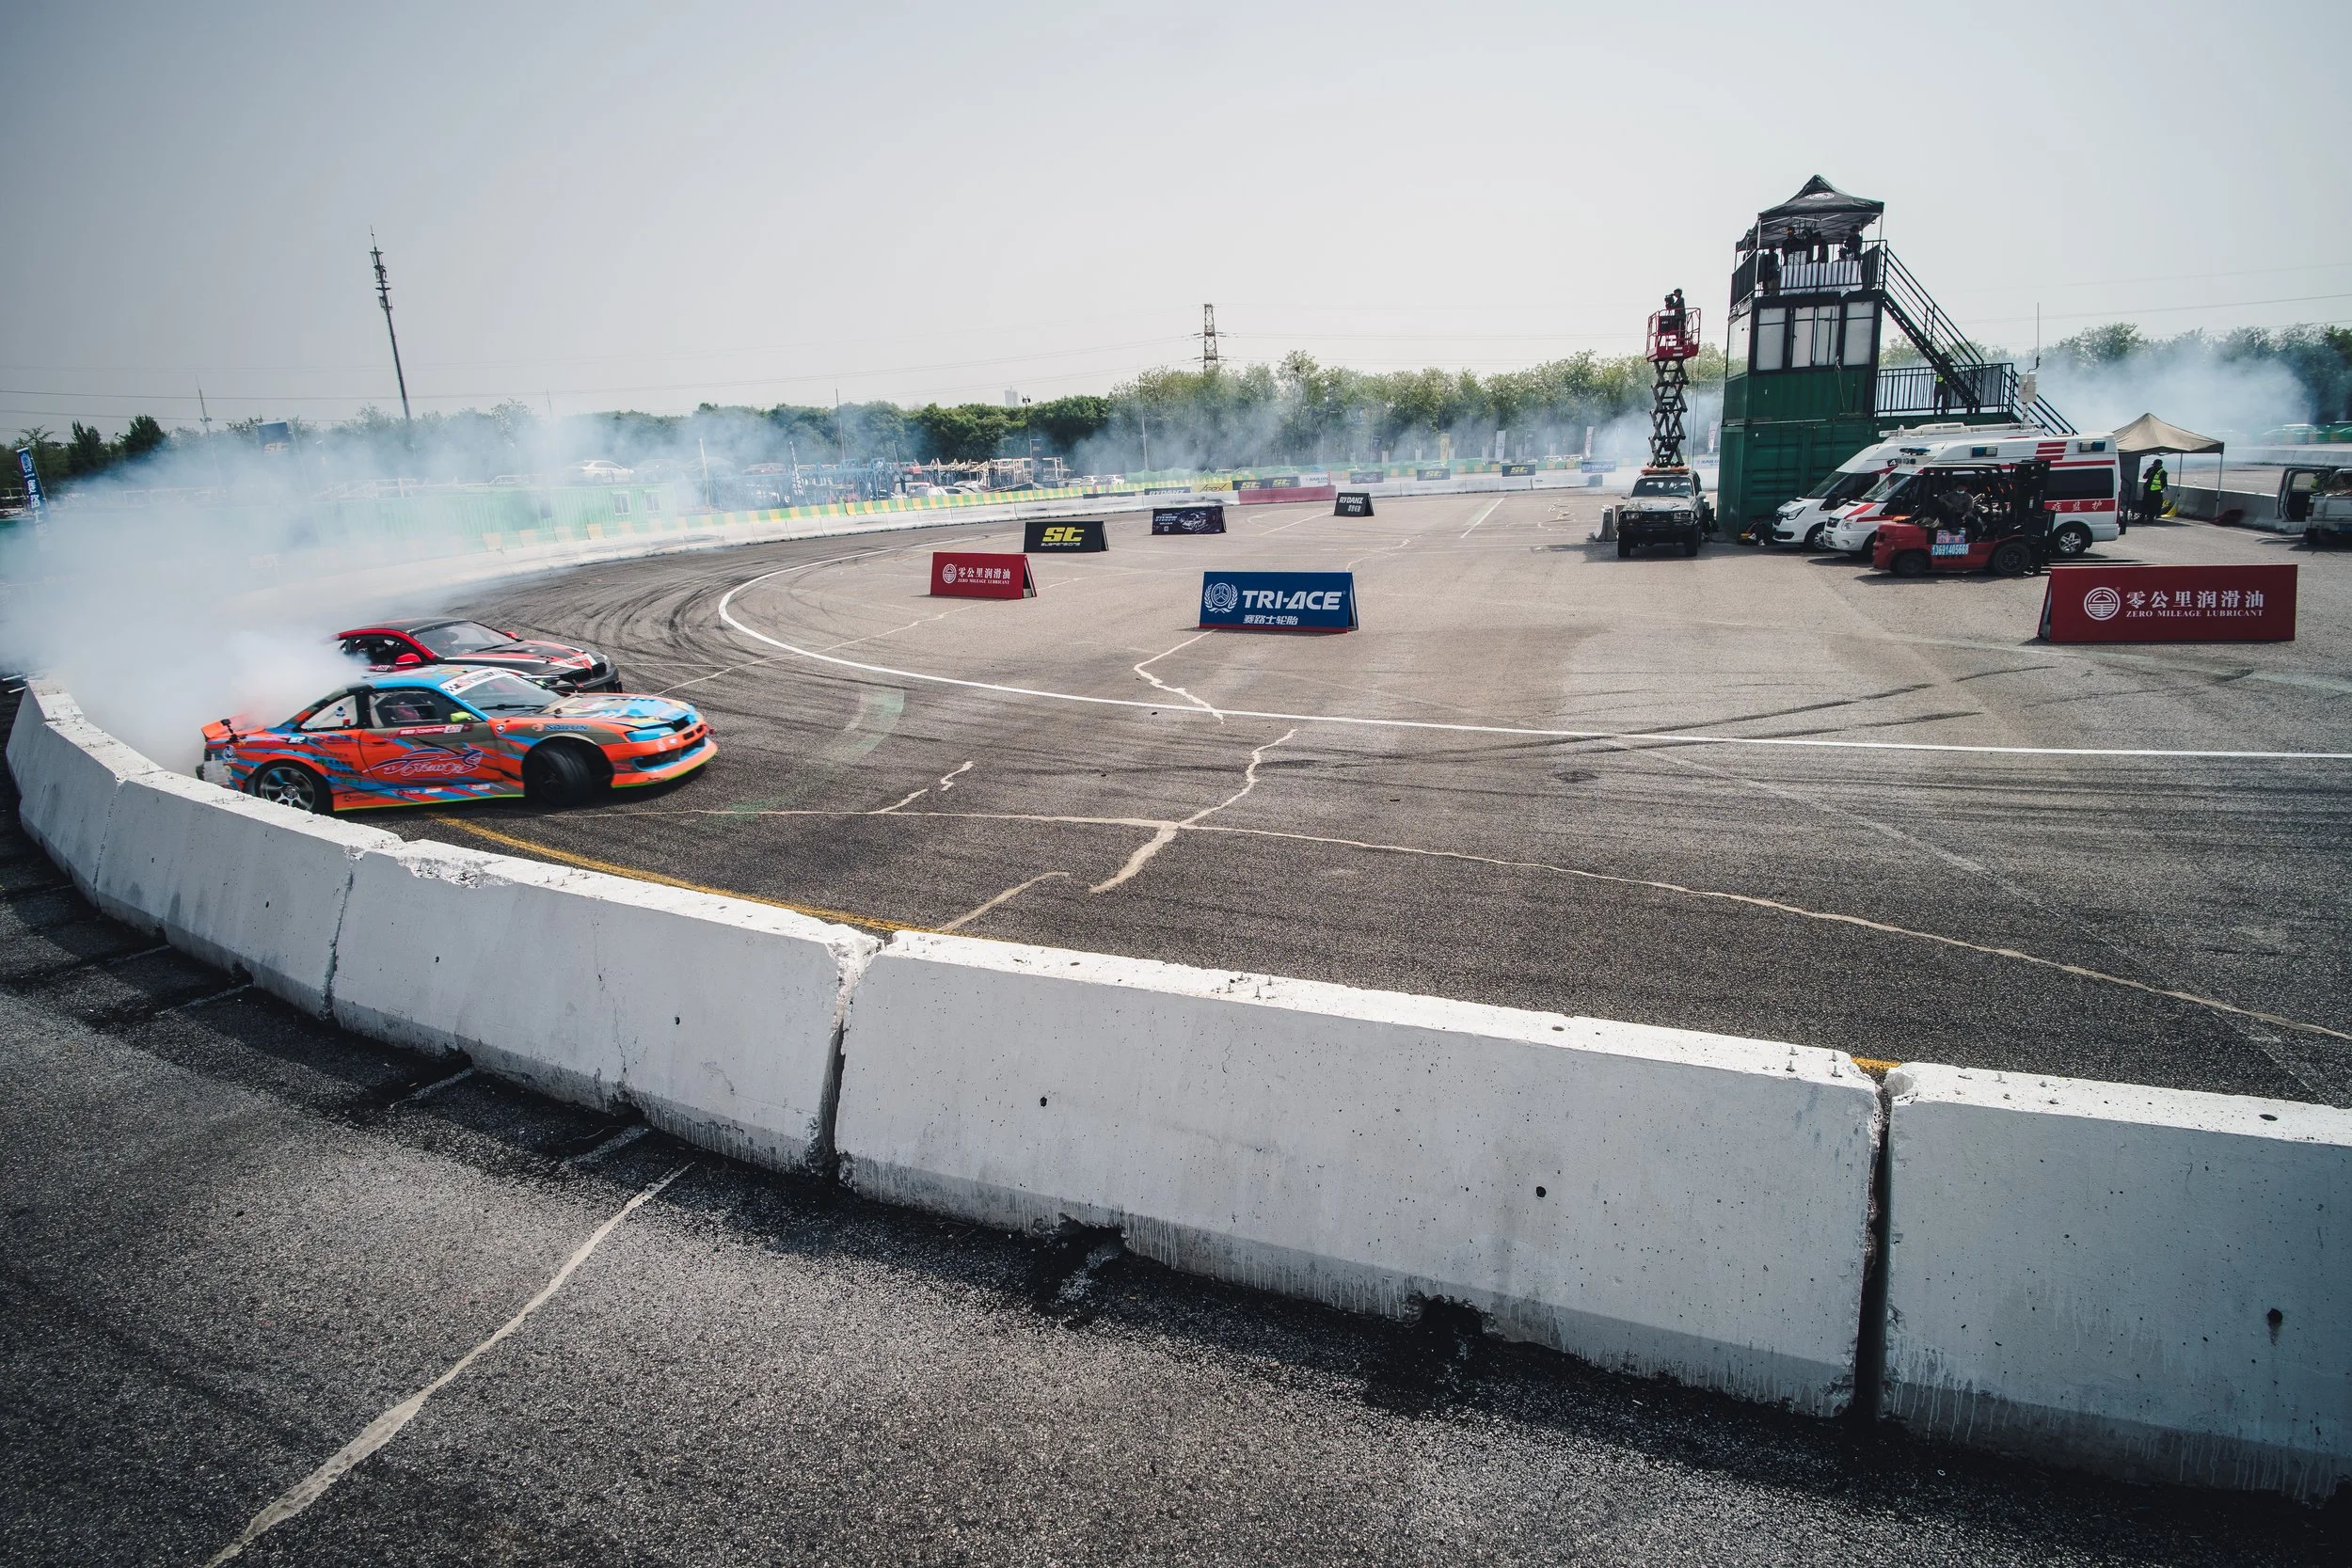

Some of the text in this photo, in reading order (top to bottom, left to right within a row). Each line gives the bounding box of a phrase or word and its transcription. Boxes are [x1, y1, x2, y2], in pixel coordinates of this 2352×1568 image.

[2051, 500, 2103, 512] 症监护
[958, 566, 1011, 579] 零公里润滑油
[1242, 590, 1343, 610] TRI-ACE
[2126, 590, 2265, 609] 零公里润滑油
[1242, 614, 1299, 626] 赛路士轮胎
[2125, 610, 2153, 618] ZERO
